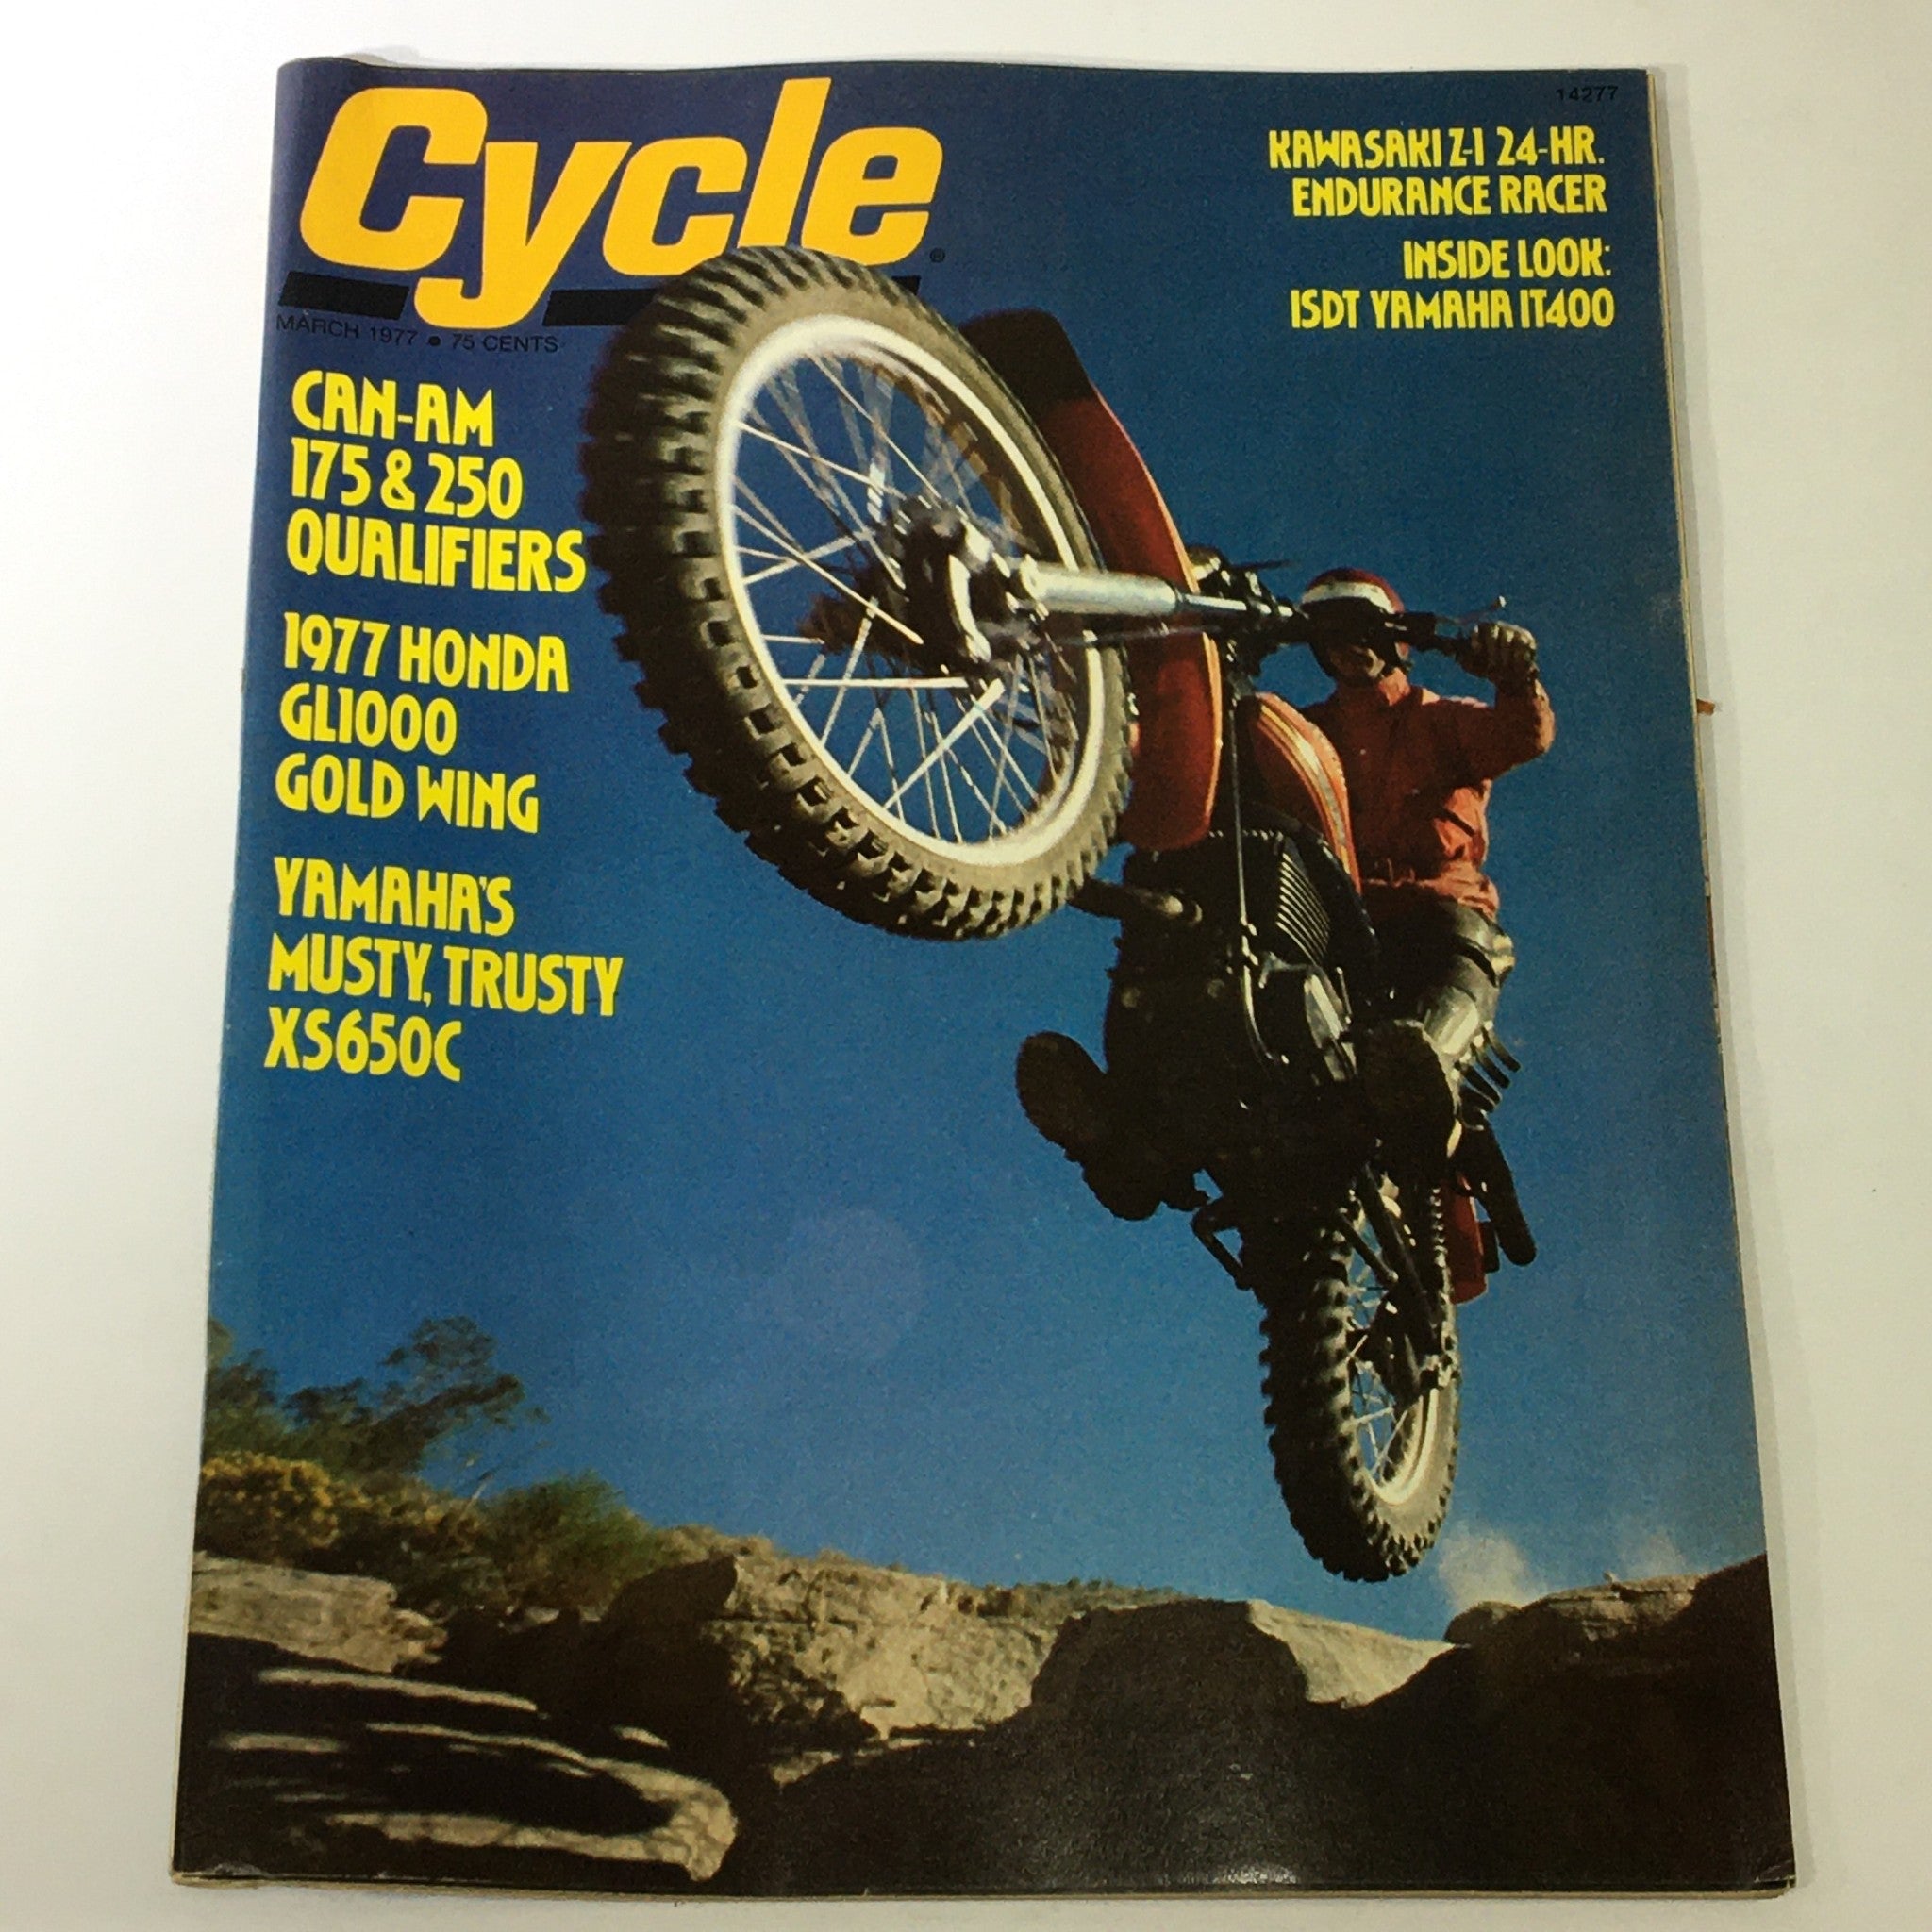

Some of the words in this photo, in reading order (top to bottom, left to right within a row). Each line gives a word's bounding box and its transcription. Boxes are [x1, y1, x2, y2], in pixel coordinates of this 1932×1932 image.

[1556, 85, 1619, 102] 14277
[1269, 129, 1442, 168] KAWASAKI
[1449, 127, 1485, 167] Z-1
[1496, 125, 1606, 166] 24-HR.
[299, 77, 943, 329] Cycle
[1291, 175, 1491, 217] ENDURANCE
[1499, 174, 1607, 214] RACER
[1403, 239, 1510, 280] INSIDE
[1517, 237, 1611, 278] LOOK:
[276, 314, 359, 338] MARCH
[371, 327, 418, 344] 1977
[452, 334, 475, 350] 75
[483, 335, 558, 352] CENTS
[1291, 289, 1360, 329] ISDT
[1371, 289, 1515, 329] YAMAHA
[1520, 288, 1615, 328] IT400
[291, 369, 494, 448] CAN-AM
[291, 436, 372, 507] 175
[380, 448, 417, 511] &
[425, 452, 524, 520] 250
[287, 508, 587, 594] QUALIFIERS
[284, 611, 391, 677] 1977
[399, 625, 570, 692] HONDA
[280, 682, 458, 756] GL1000
[275, 752, 406, 819] GOLD
[418, 765, 539, 834] WING
[274, 856, 515, 937] YAMAHA'S
[268, 932, 433, 1007] MUSTY,
[443, 945, 624, 1016] TRUSTY
[264, 1006, 462, 1082] XS650C
